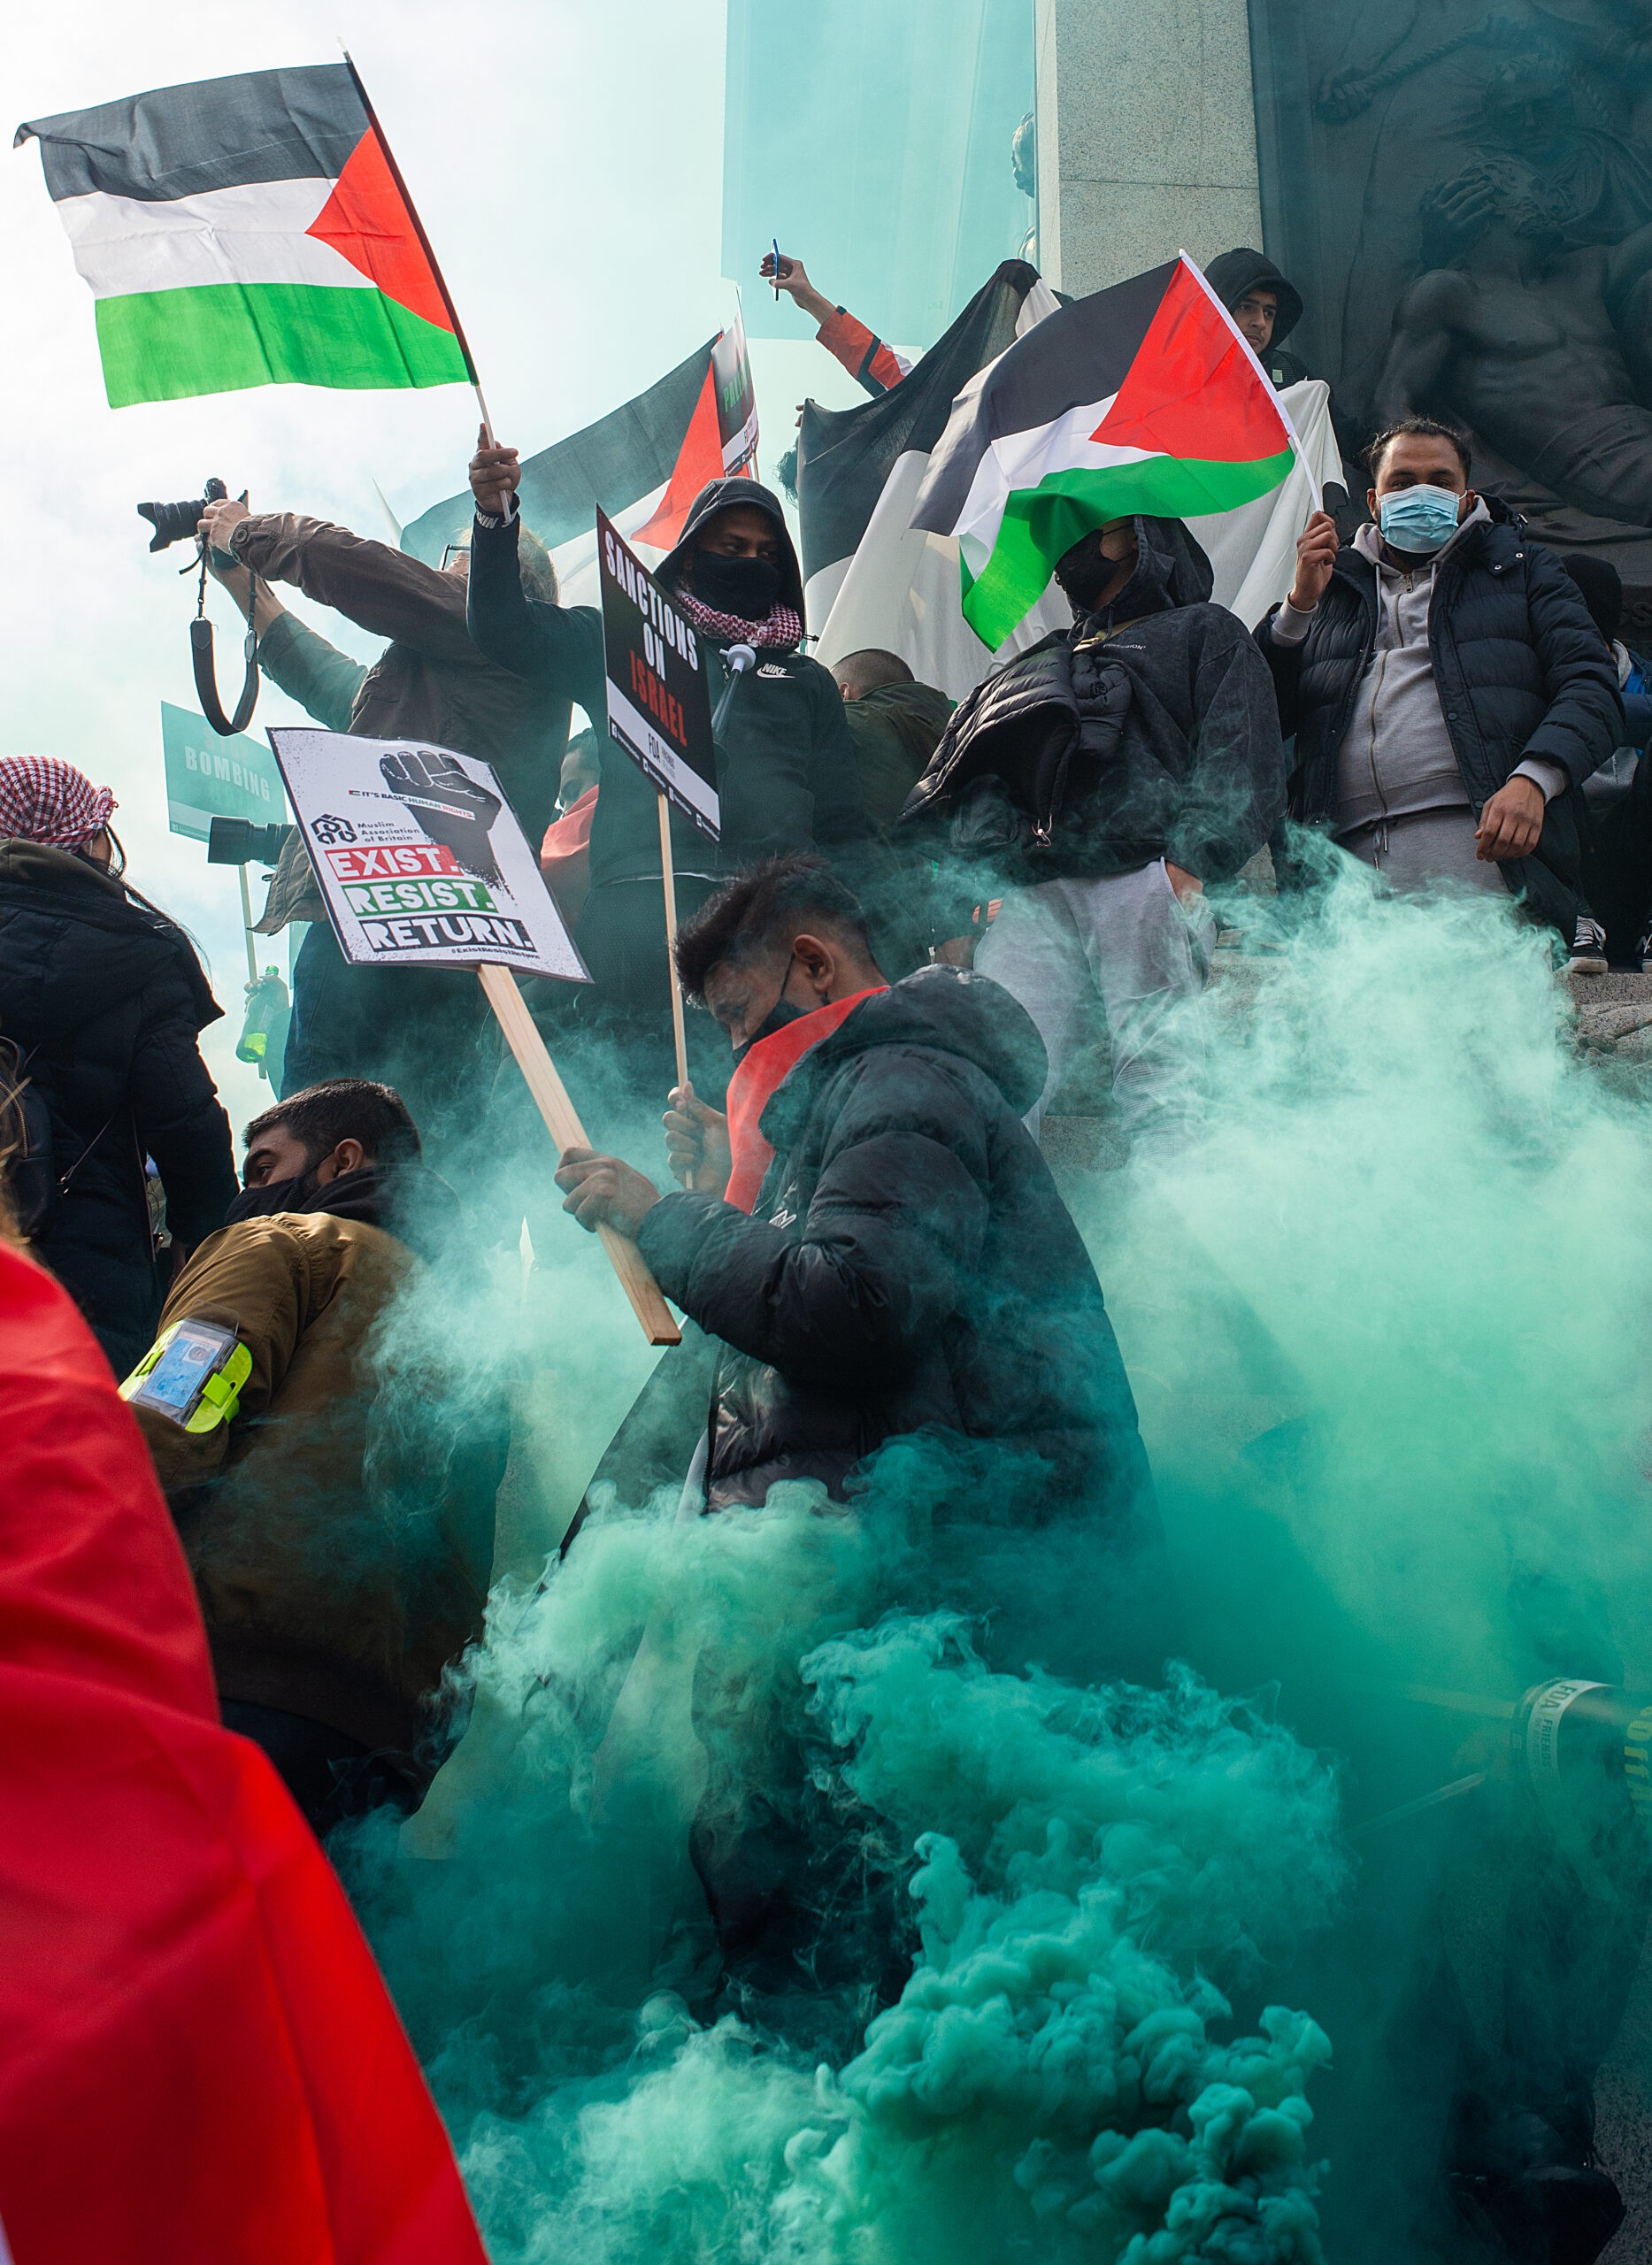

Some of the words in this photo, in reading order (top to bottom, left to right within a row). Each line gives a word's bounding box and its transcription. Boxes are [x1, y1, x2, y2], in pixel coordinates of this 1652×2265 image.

[605, 531, 699, 672] SANCTIONS
[643, 622, 666, 681] ON
[762, 663, 788, 677] NIKE
[629, 649, 688, 747] ISRAEL
[648, 733, 661, 763] FOA
[185, 745, 270, 802] BOMBING
[381, 793, 407, 802] BASIC
[409, 797, 441, 810] HUMAN
[442, 805, 474, 817] RIGHTS
[327, 847, 459, 879] EXIST.
[344, 881, 496, 915] RESIST.
[362, 918, 534, 949] RETURN.
[1541, 1685, 1578, 1710] FOA
[1541, 1719, 1553, 1770] FRIENDS
